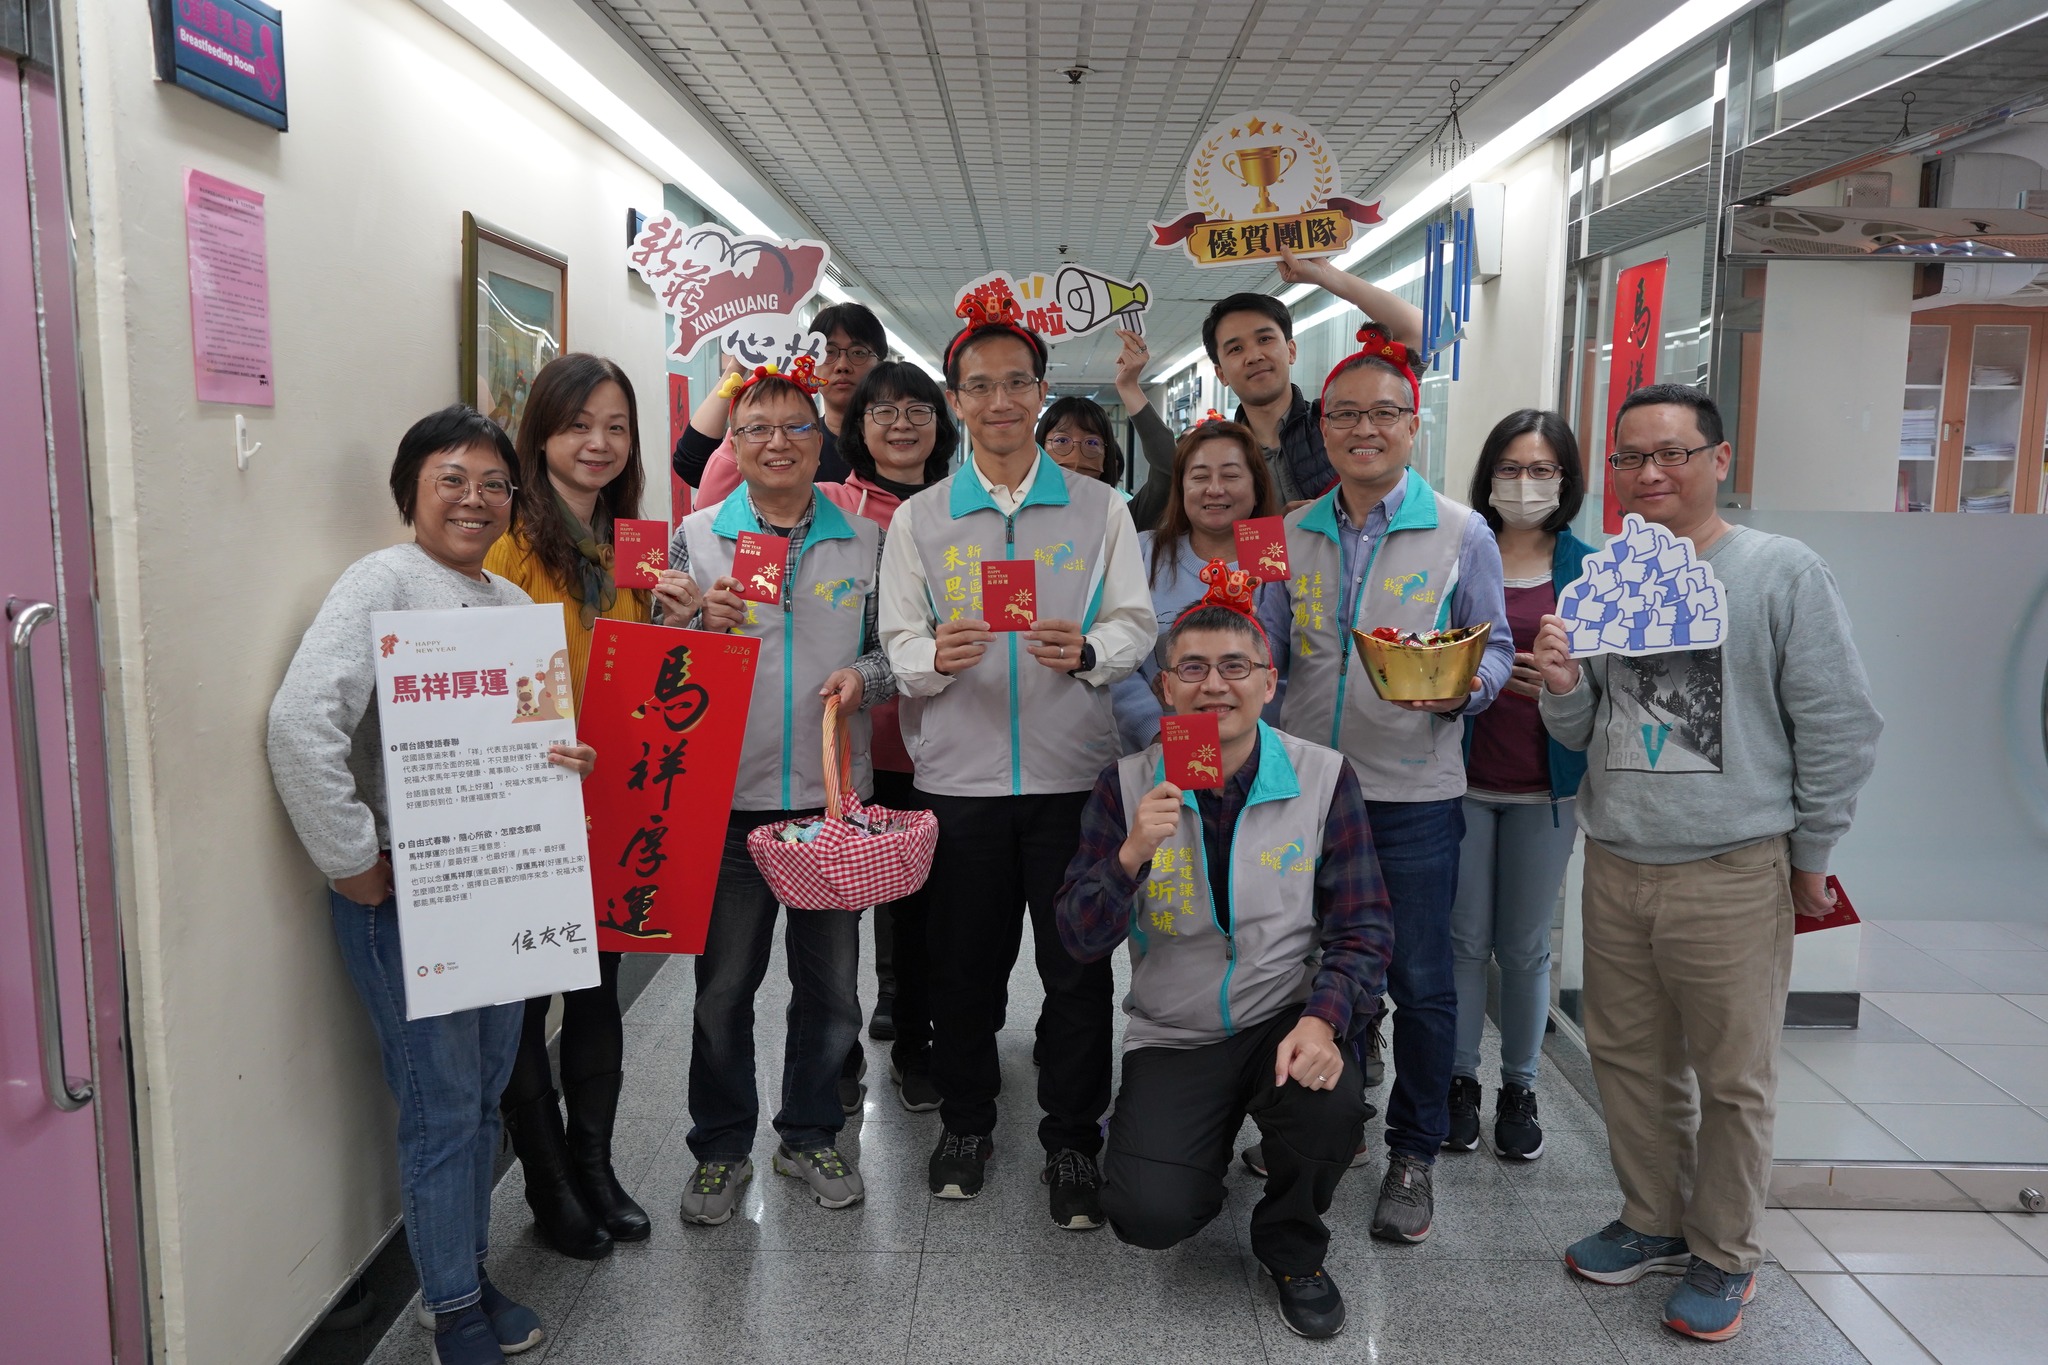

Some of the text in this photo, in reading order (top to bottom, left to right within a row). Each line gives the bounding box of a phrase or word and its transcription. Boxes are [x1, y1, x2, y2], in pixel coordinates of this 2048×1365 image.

[180, 28, 255, 75] Breastfeeding Room
[1207, 216, 1338, 258] 優質團隊
[690, 293, 778, 336] XINZHUANG
[966, 544, 983, 611] 新莊區長
[724, 645, 750, 655] 2026
[392, 668, 509, 704] 馬祥厚運
[554, 657, 569, 709] 馬祥厚運
[598, 645, 709, 938] 馬祥厚運
[1179, 847, 1195, 915] 經建課長
[511, 921, 586, 954] 侯友宜
